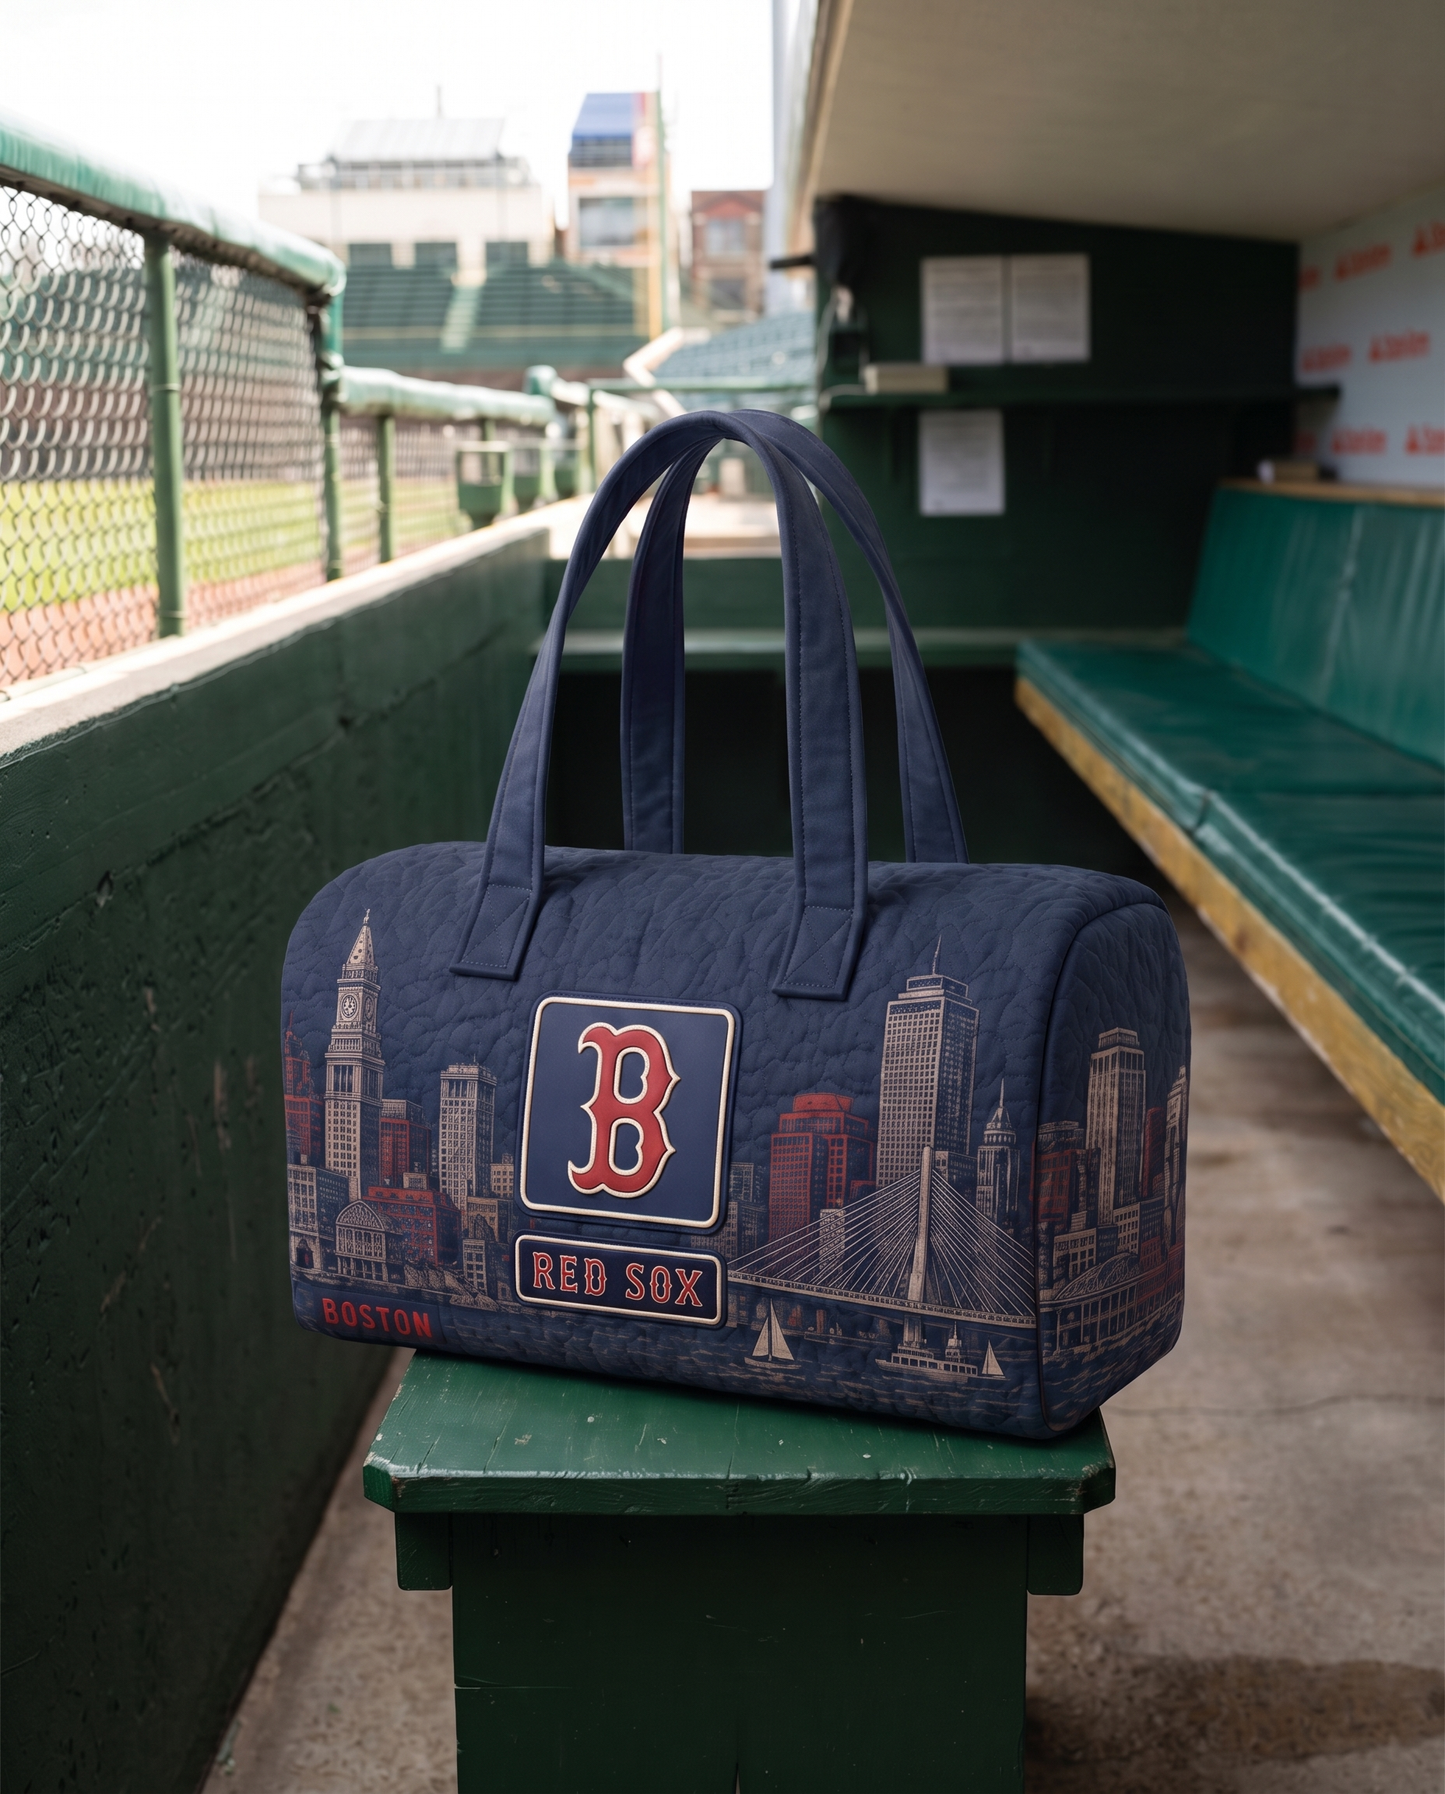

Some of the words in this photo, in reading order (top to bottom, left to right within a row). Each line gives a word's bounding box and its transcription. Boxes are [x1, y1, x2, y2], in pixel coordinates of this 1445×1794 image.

[567, 1022, 681, 1198] B
[532, 1252, 607, 1297] RED
[625, 1263, 703, 1307] SOX
[321, 1297, 433, 1338] BOSTON
